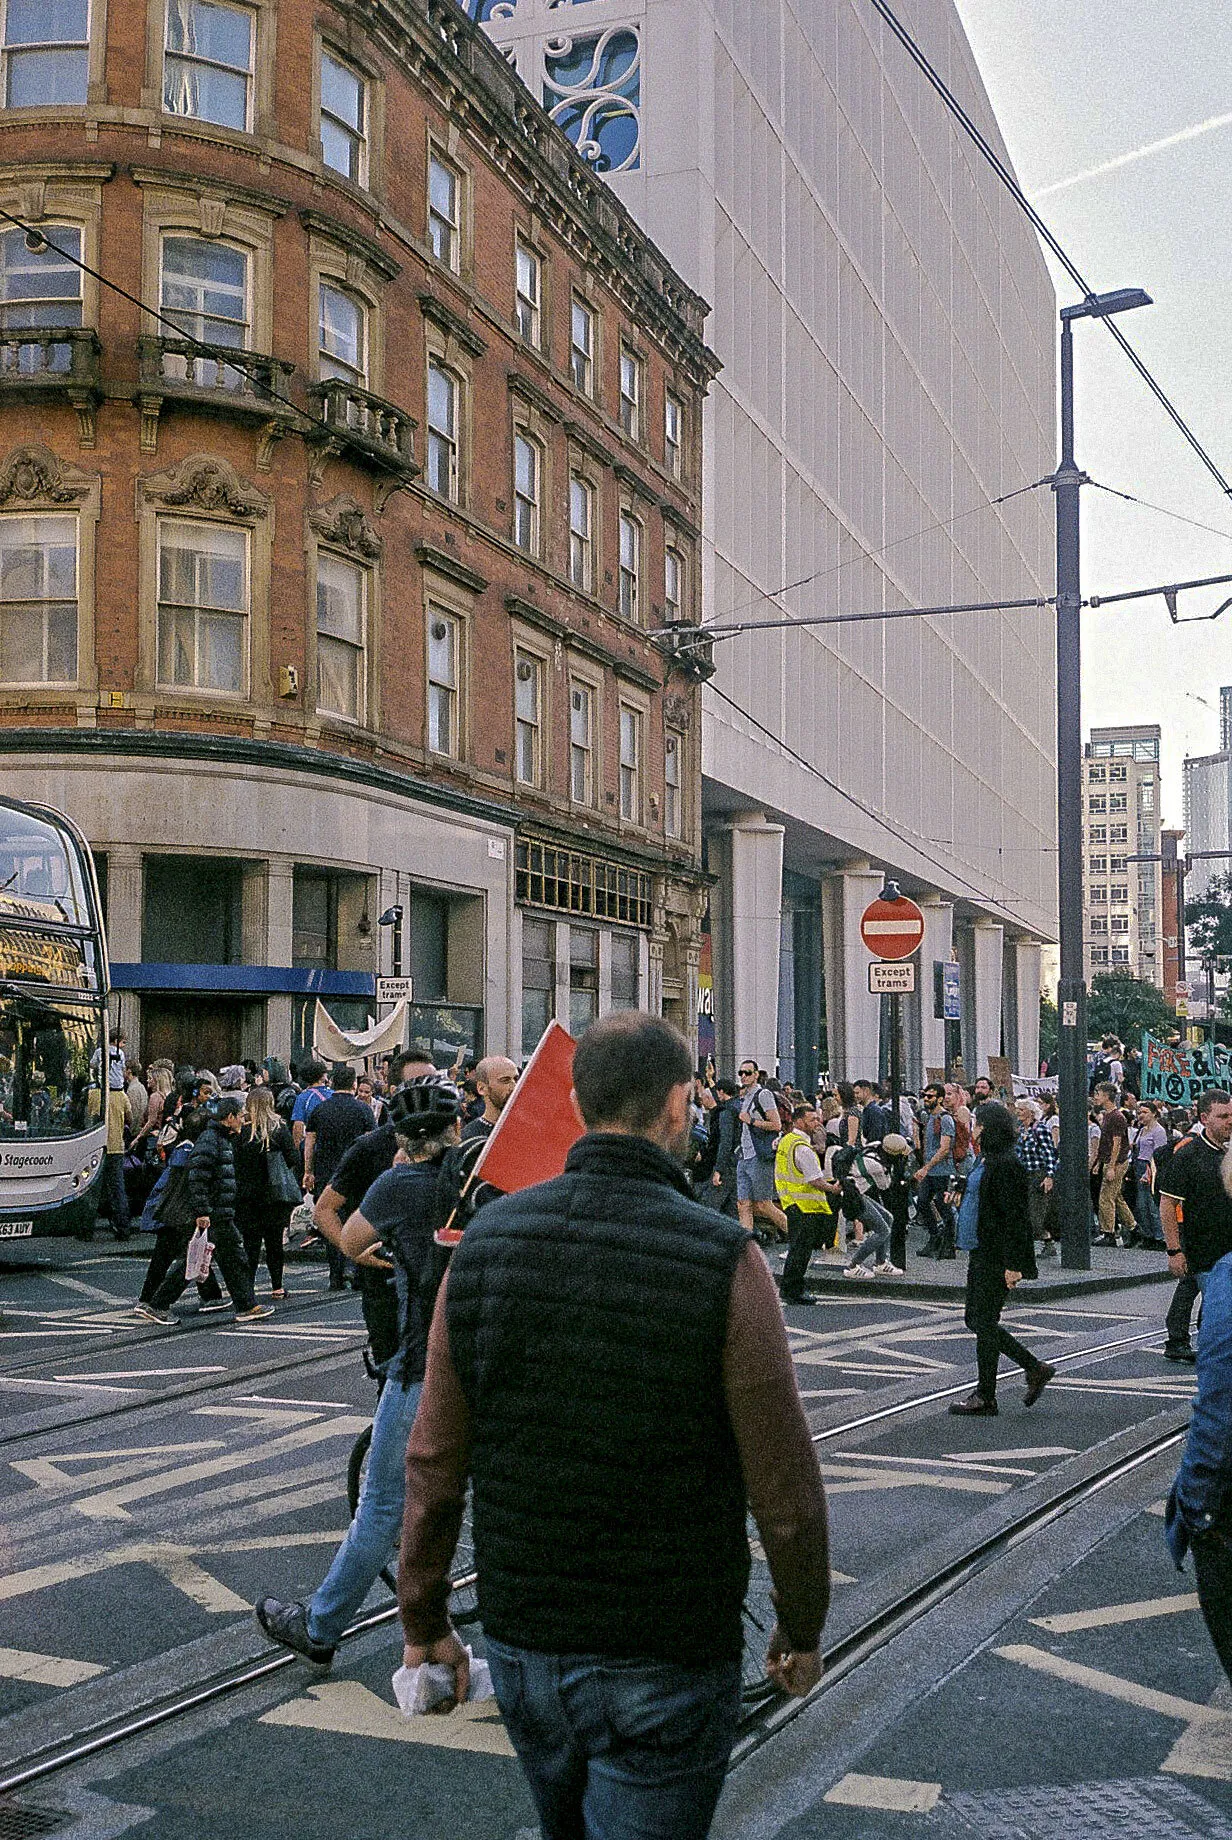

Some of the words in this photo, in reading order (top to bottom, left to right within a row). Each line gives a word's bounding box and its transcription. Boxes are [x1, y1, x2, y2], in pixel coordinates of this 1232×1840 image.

[874, 967, 912, 978] Except
[380, 980, 410, 990] Except
[877, 979, 908, 988] trams
[1147, 1041, 1191, 1078] FIRE
[1192, 1049, 1212, 1077] &
[1146, 1072, 1162, 1095] IN
[4, 1153, 54, 1169] Stagecoach
